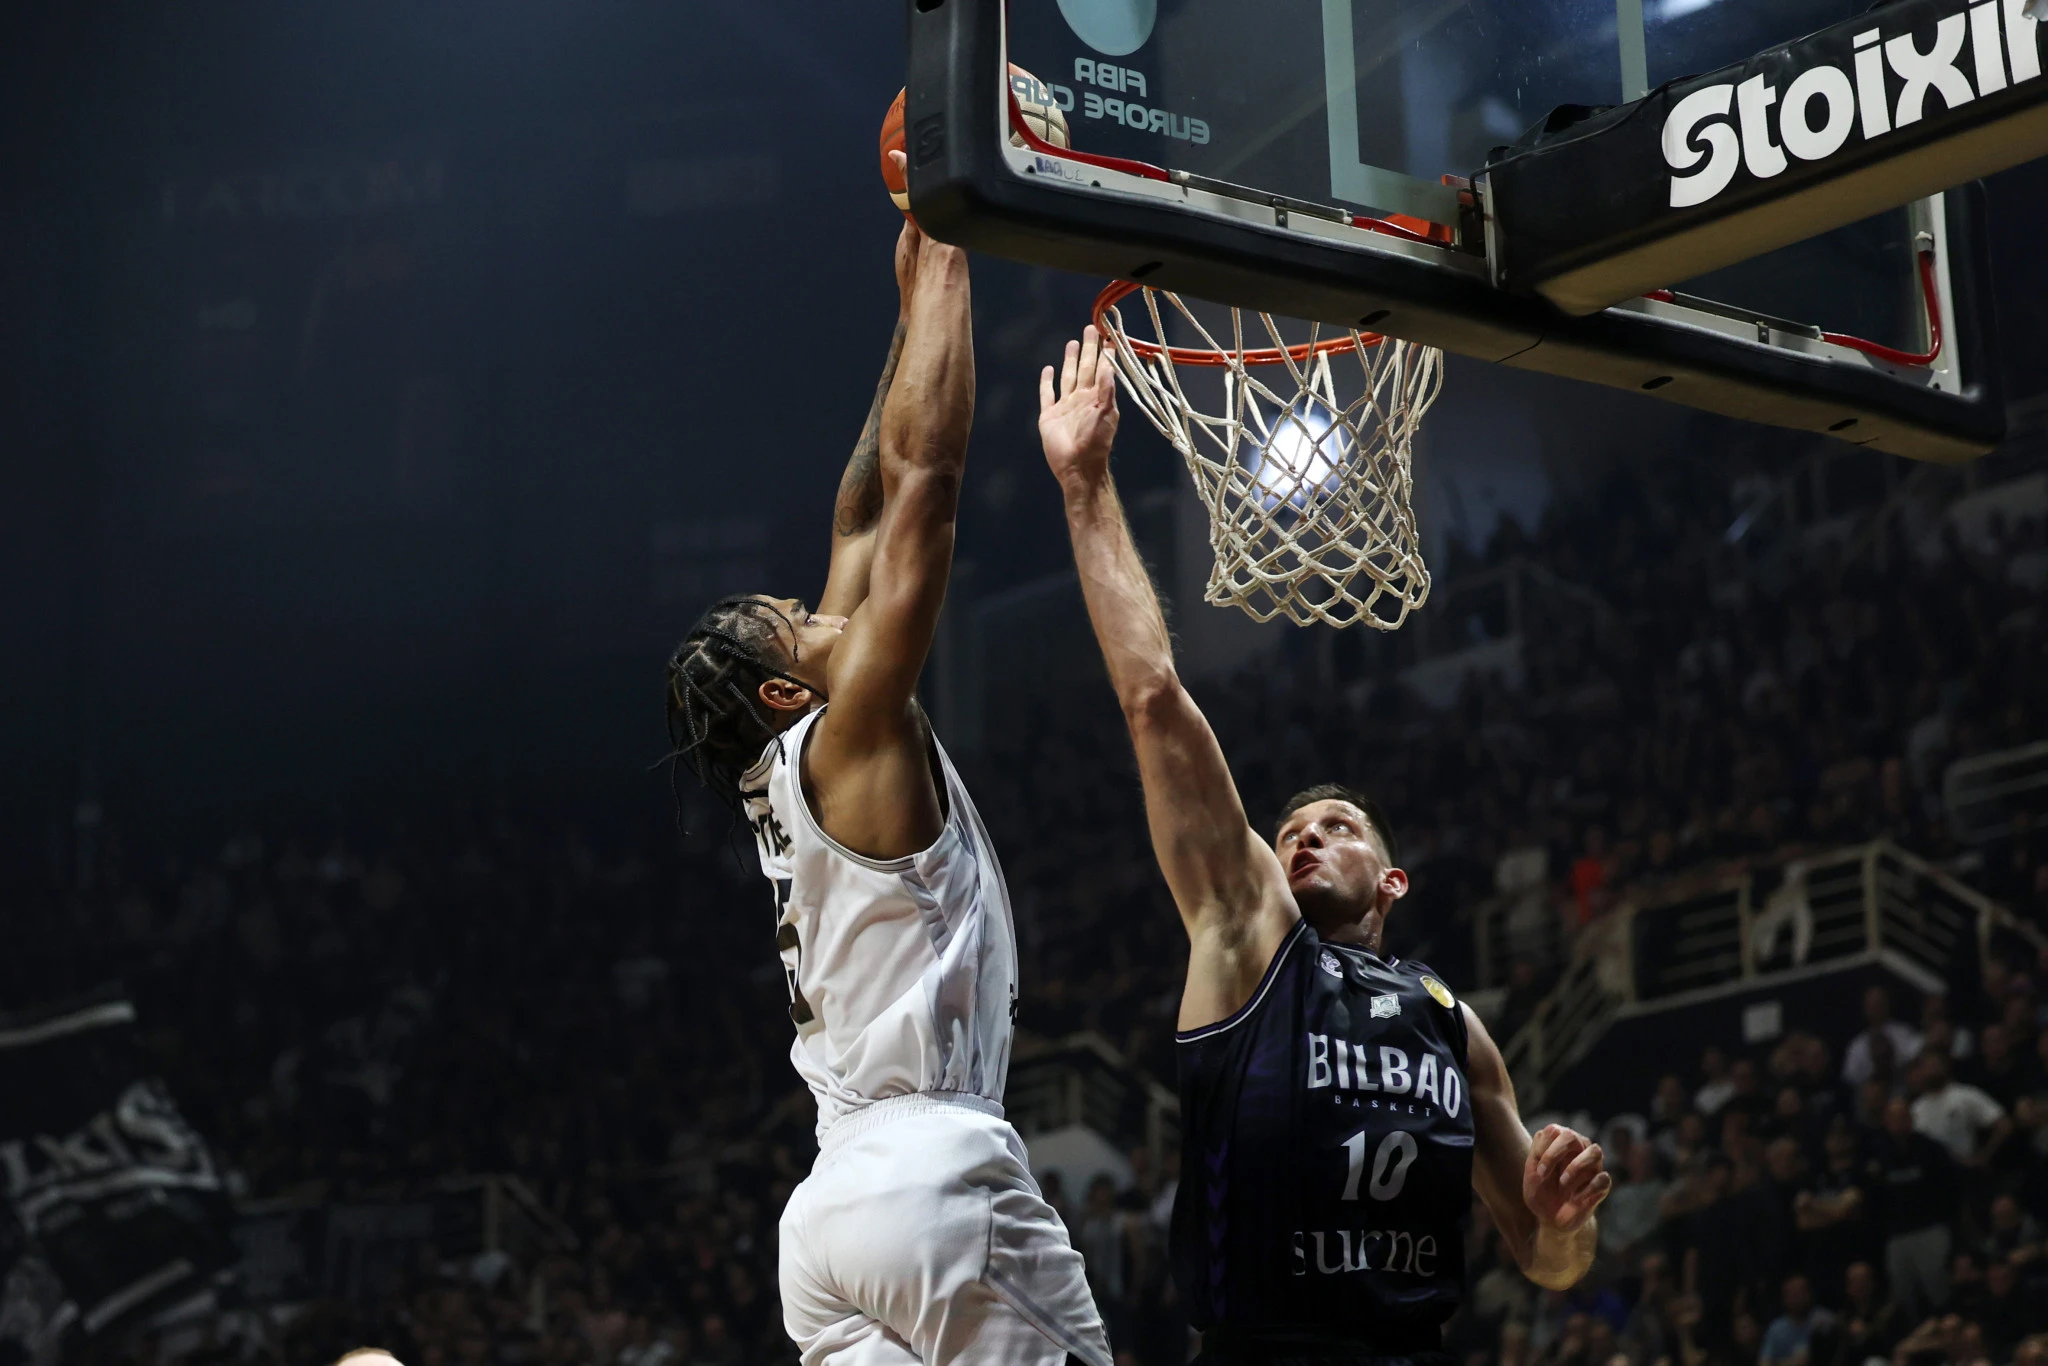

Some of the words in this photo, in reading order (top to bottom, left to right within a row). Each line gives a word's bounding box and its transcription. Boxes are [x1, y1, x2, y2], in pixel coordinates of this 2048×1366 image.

[1307, 1032, 1461, 1119] BILBAO
[1334, 1094, 1431, 1117] BASKET
[1341, 1130, 1418, 1201] 10
